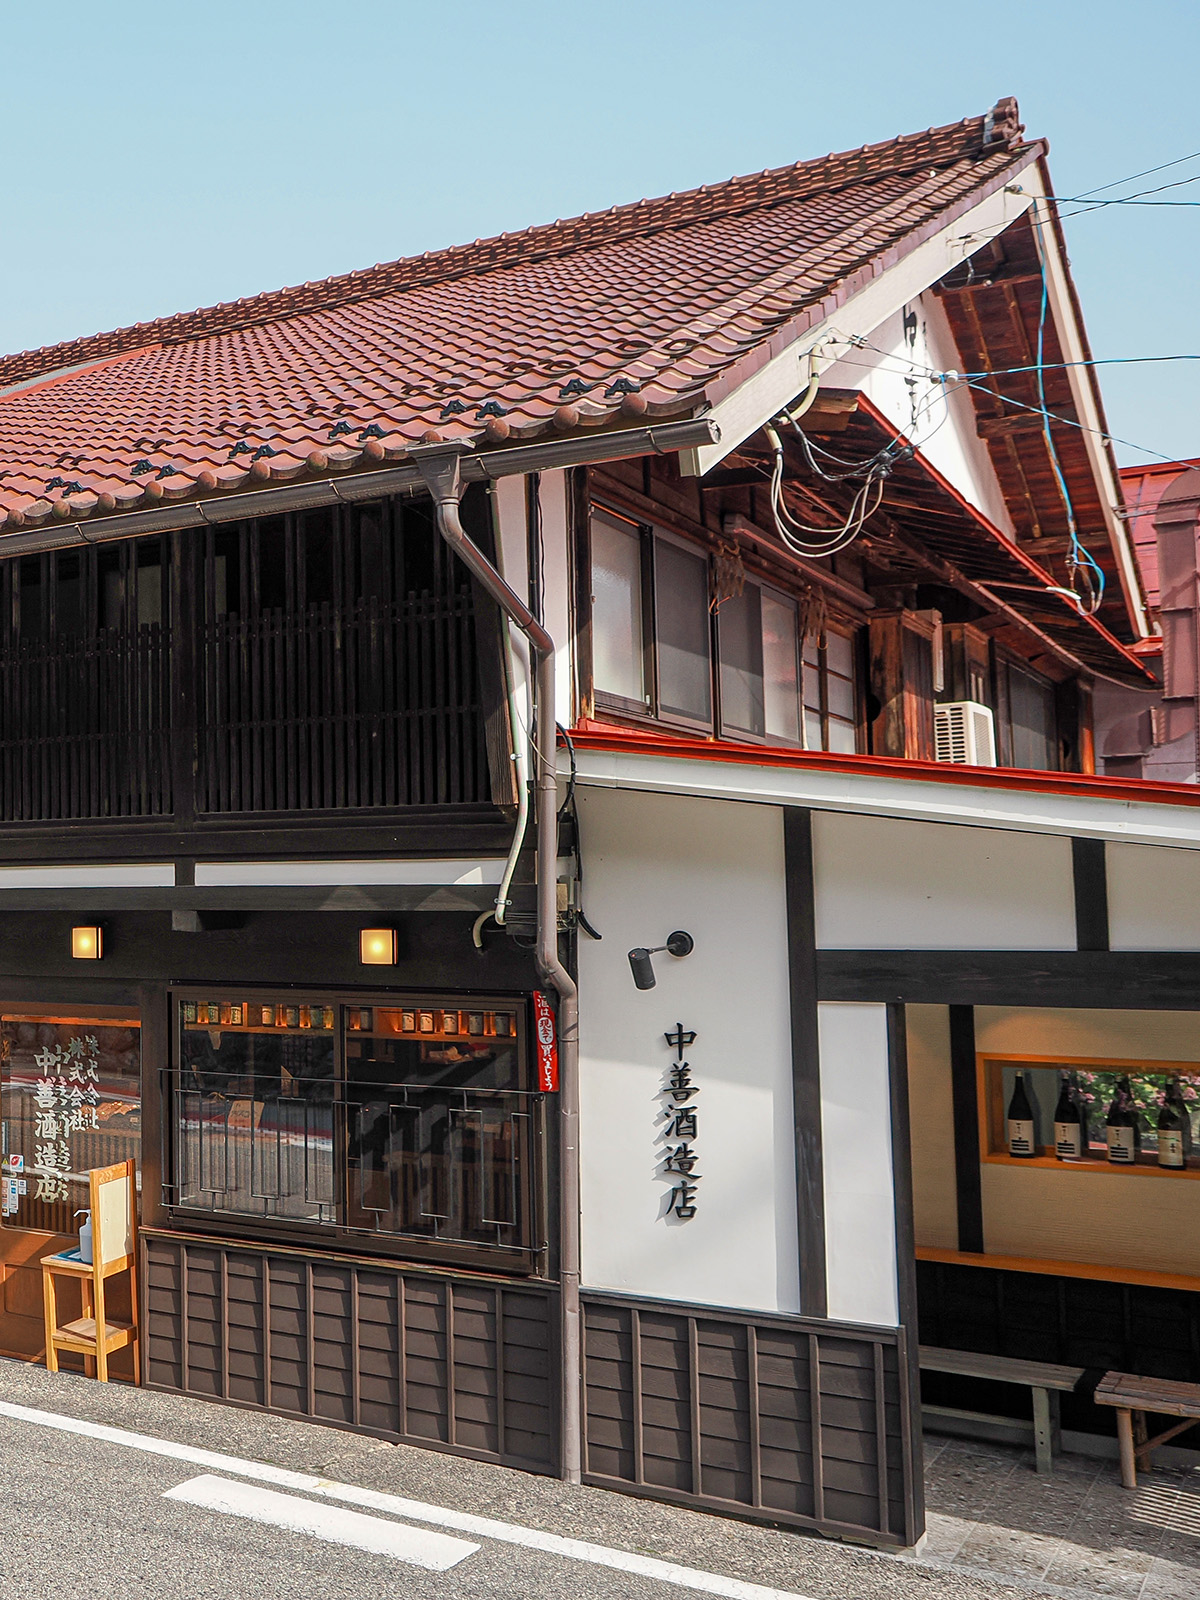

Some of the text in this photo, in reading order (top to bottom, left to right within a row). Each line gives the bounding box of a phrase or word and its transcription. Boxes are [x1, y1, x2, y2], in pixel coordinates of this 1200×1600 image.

[33, 1044, 58, 1204] 中善酒造店
[68, 1036, 86, 1132] 株式会社
[663, 1022, 702, 1219] 中善酒造店
